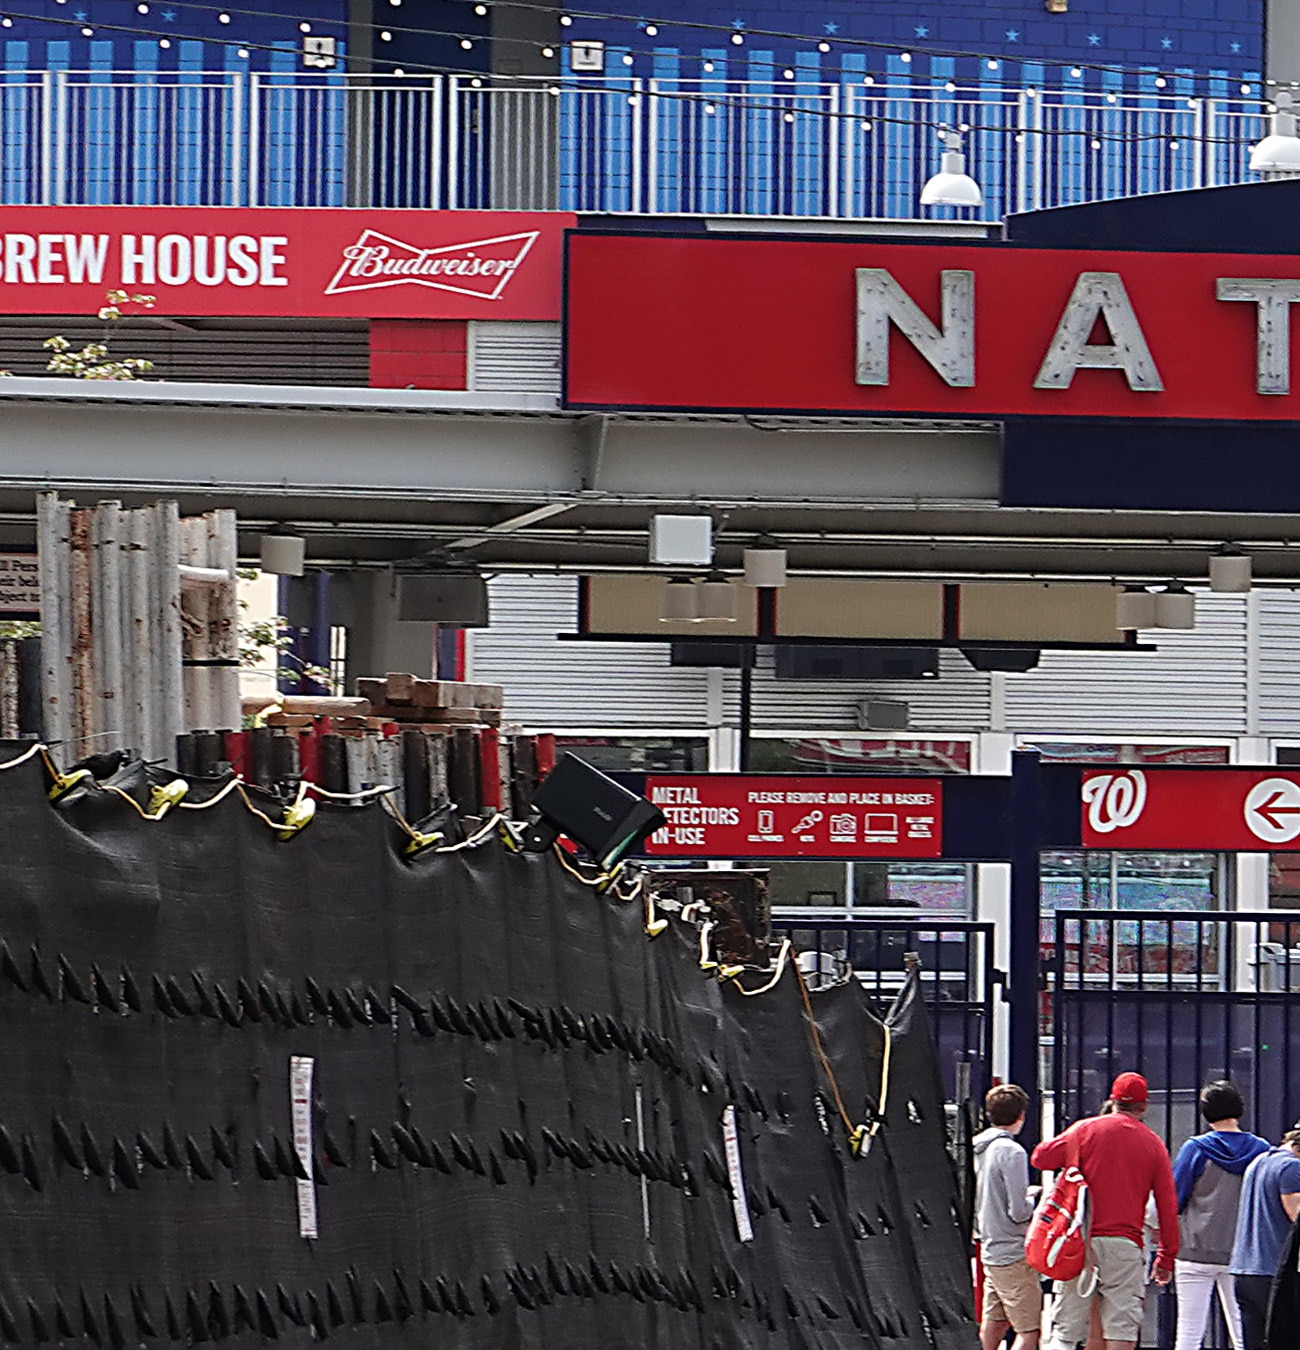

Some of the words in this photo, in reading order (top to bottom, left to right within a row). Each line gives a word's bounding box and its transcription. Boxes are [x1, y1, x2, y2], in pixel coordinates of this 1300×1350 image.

[0, 232, 104, 286] REW
[121, 233, 288, 288] HOUSE
[343, 245, 517, 277] Budweiser
[12, 559, 38, 572] Pers
[651, 786, 702, 805] METAL
[747, 791, 785, 804] PLEASE
[786, 791, 826, 804] REMOVE
[828, 792, 848, 804] AND
[850, 792, 880, 805] PLACE
[882, 792, 894, 805] IN
[1081, 769, 1148, 834] W
[662, 806, 740, 826] ETECTORS
[651, 826, 706, 845] IN-USE
